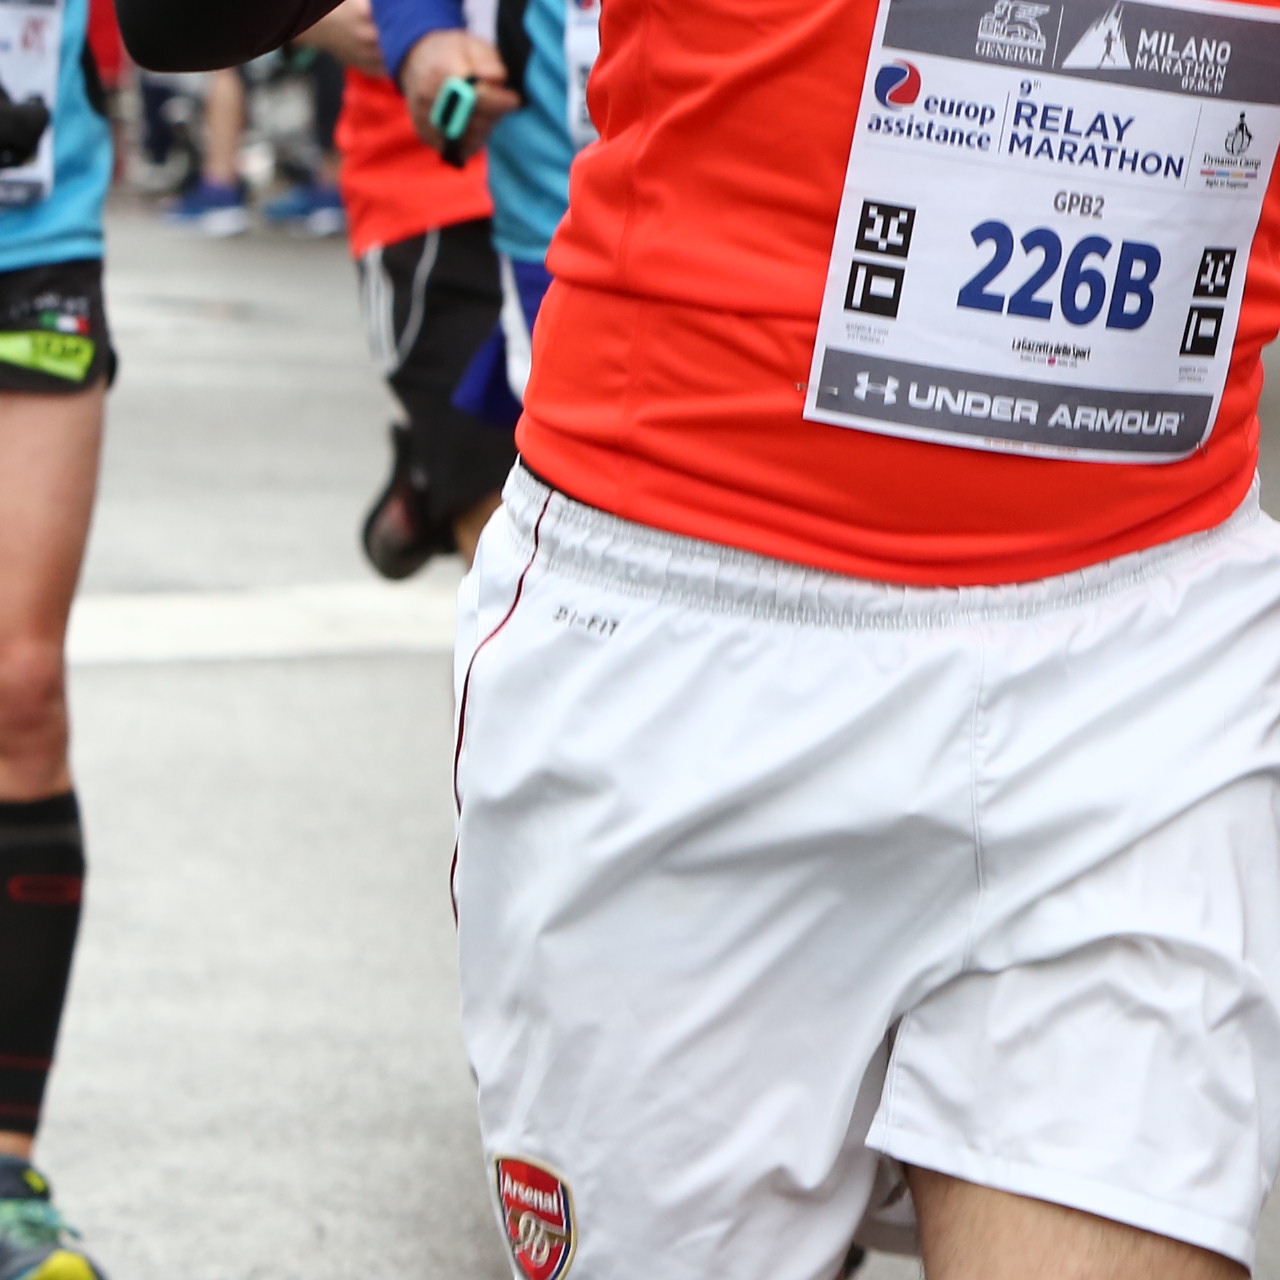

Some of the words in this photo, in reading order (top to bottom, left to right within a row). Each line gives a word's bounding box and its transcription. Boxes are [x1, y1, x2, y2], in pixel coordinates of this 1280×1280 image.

[1134, 51, 1227, 81] MARATHON
[1137, 28, 1231, 65] MILANO
[923, 95, 996, 128] europ
[1012, 98, 1136, 143] RELAY
[866, 113, 991, 152] assistance
[1008, 131, 1185, 180] MARATHON
[1053, 190, 1105, 220] GPB2
[956, 219, 1163, 331] 226B
[908, 381, 1039, 425] UNDER
[1047, 403, 1183, 437] ARMOUR
[504, 1172, 559, 1216] Arsenal
